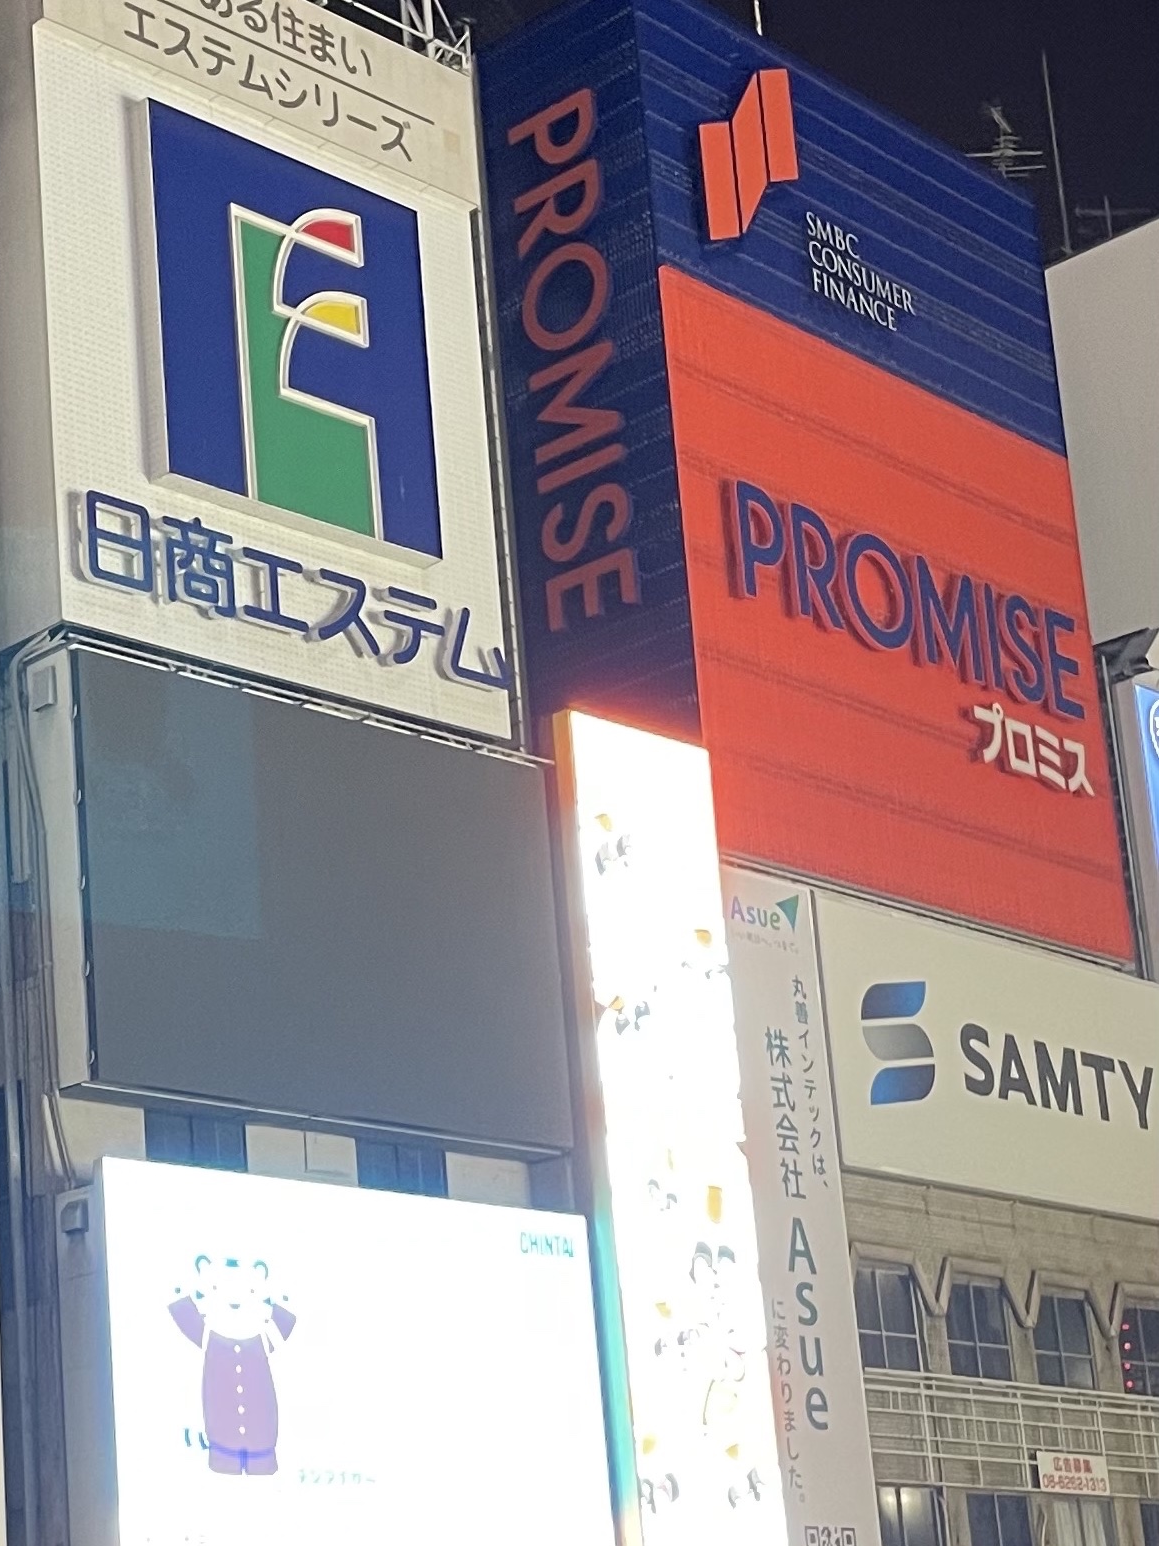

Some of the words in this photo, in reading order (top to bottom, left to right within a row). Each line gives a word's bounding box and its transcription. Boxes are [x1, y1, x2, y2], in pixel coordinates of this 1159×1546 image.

[123, 2, 412, 162] エステムシリーズ
[806, 211, 860, 259] SMBC
[809, 241, 916, 316] CONSUMER
[812, 267, 897, 331] FINANCE
[508, 87, 638, 632] PROMISE
[86, 490, 511, 689] 日商エステム
[736, 480, 1086, 719] PROMISE
[973, 702, 1096, 797] プロミス
[730, 896, 781, 931] Asue
[959, 1022, 1154, 1131] SAMTY
[765, 1026, 807, 1200] 株式会社
[787, 1215, 830, 1432] Asue
[771, 1297, 806, 1504] に変わりました。
